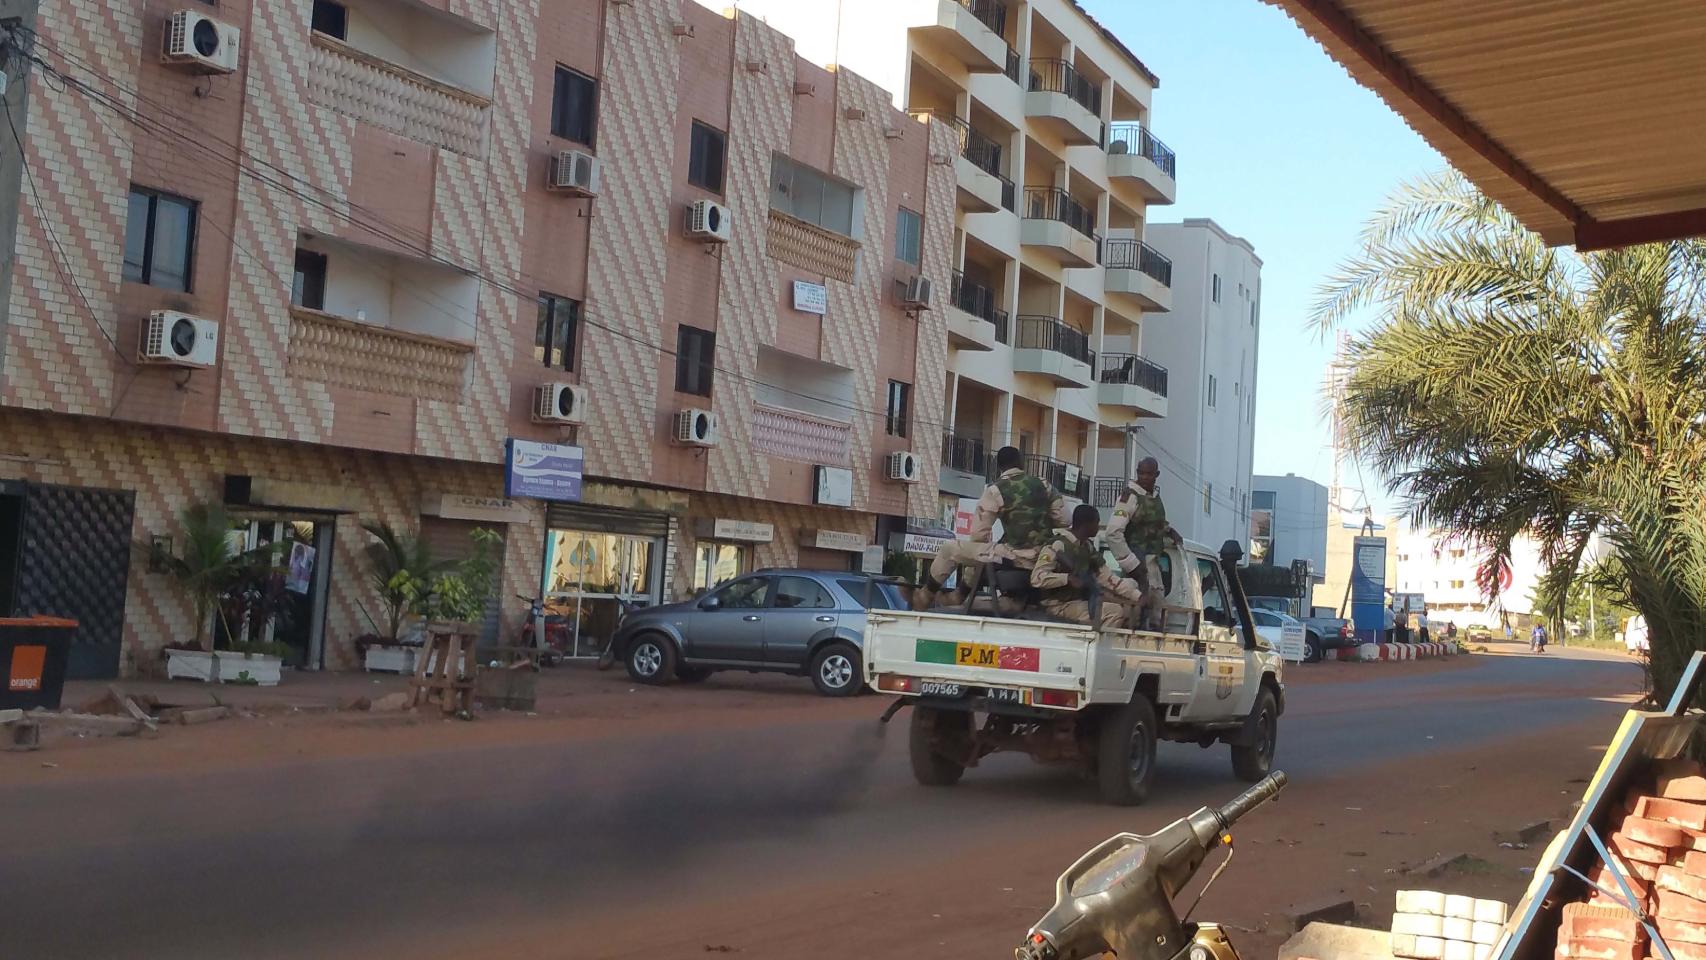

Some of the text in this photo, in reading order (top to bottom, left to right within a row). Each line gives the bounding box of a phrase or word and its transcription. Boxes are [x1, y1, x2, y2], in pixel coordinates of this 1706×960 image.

[205, 331, 214, 340] LG
[10, 679, 38, 689] orange
[922, 683, 959, 695] 007565
